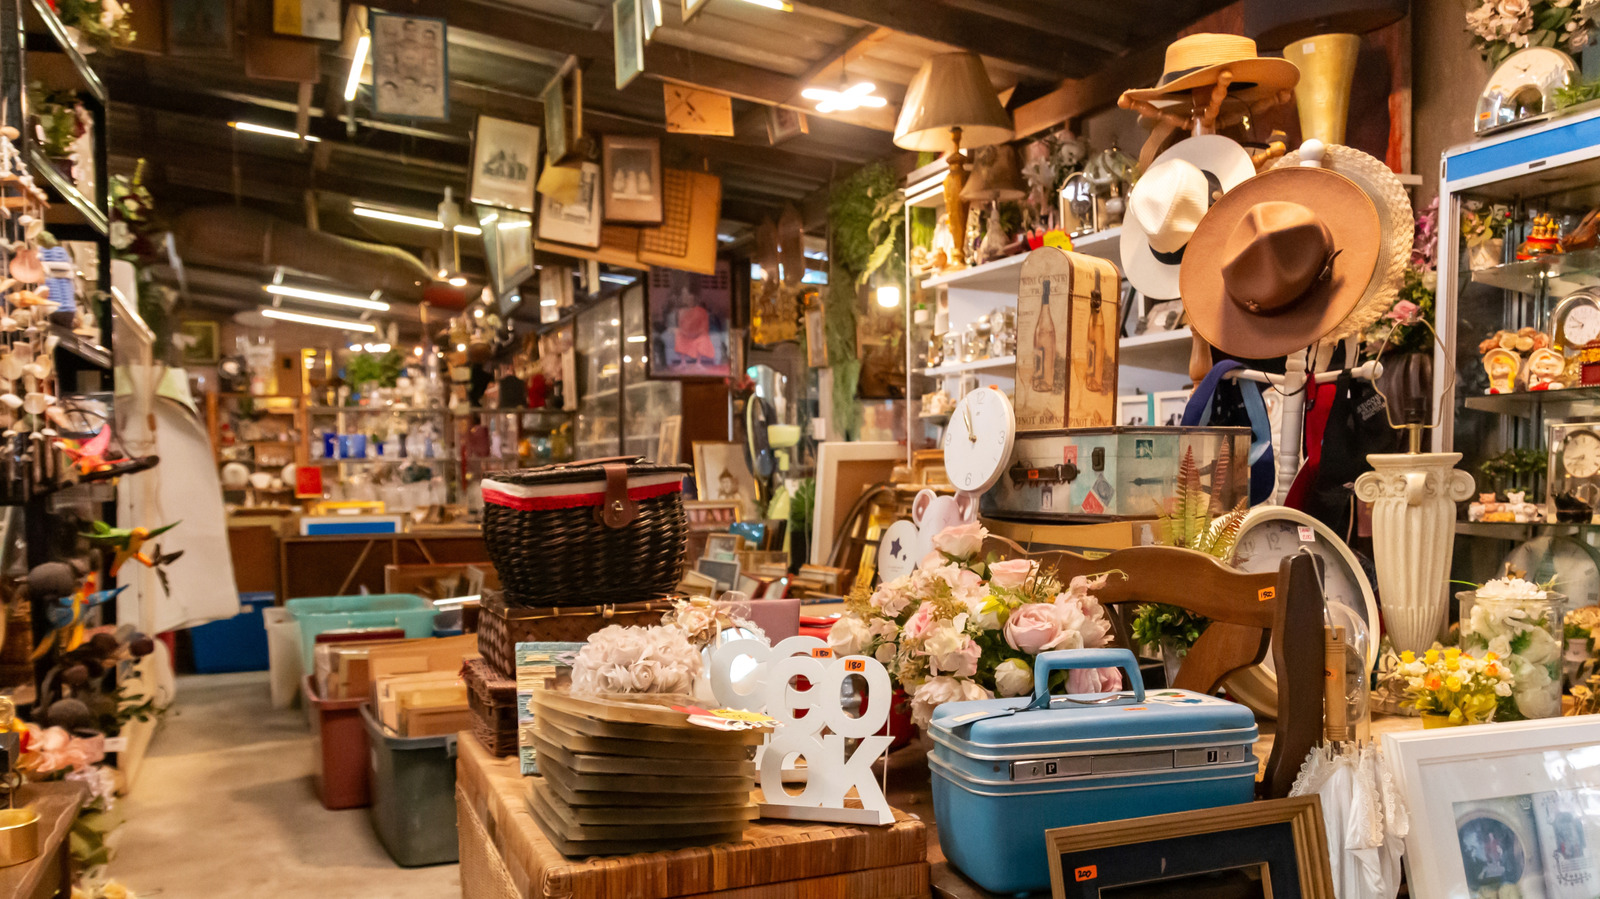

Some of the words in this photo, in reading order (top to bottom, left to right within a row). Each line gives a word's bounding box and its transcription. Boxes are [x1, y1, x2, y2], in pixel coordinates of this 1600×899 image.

[1266, 532, 1281, 550] 12
[848, 661, 862, 670] 180
[1077, 870, 1092, 878] 200
